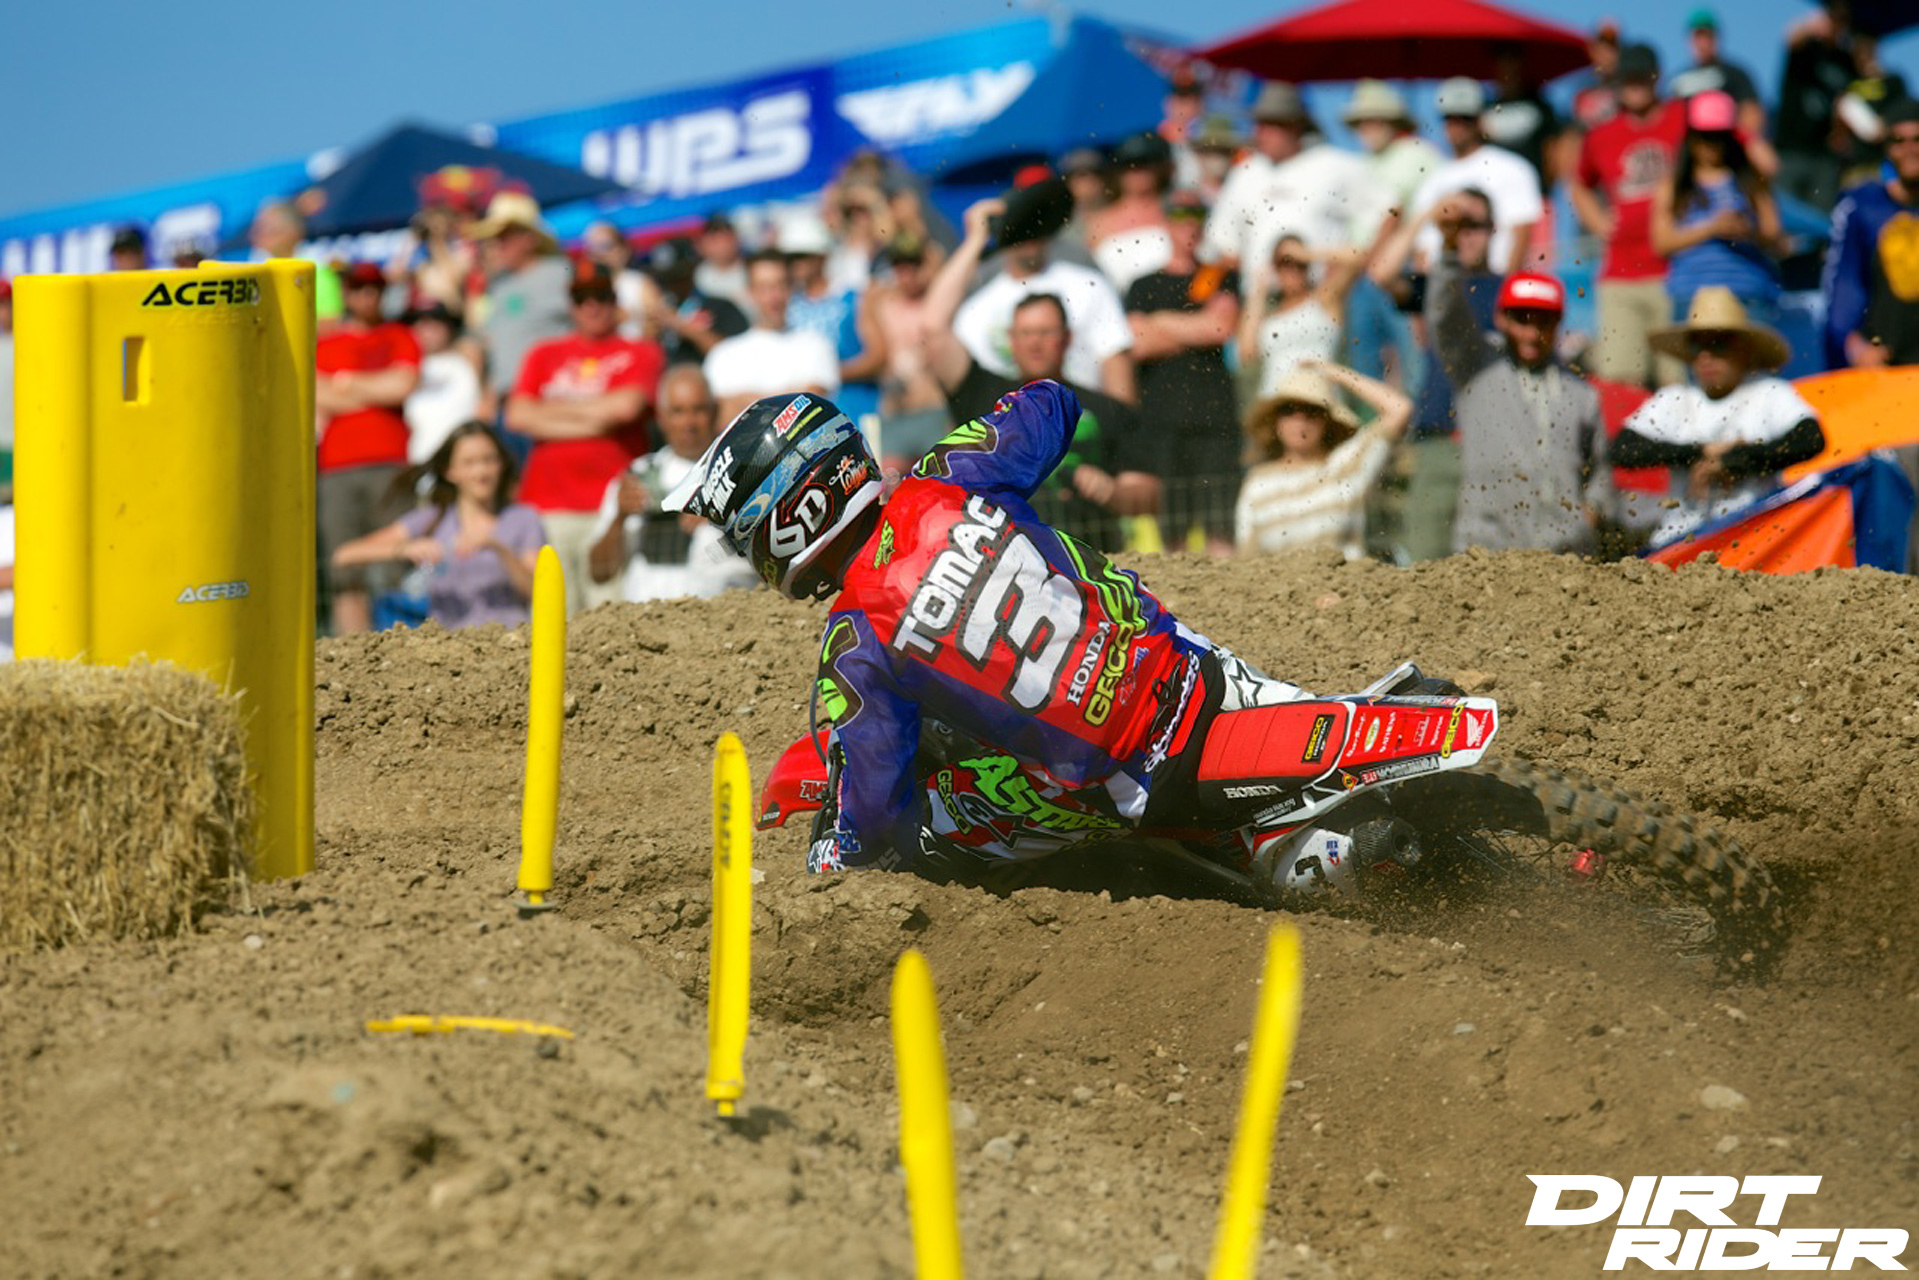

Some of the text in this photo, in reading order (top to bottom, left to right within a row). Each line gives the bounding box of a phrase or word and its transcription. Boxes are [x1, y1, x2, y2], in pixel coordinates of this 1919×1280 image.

[581, 89, 812, 198] WPS
[773, 395, 812, 437] AMSOIL
[701, 446, 734, 506] MUSCLE
[711, 471, 737, 519] MILK
[893, 494, 1007, 655] TOMAC
[962, 532, 1083, 709] 3
[1066, 620, 1112, 707] HONDA
[1084, 622, 1135, 726] GEICO
[1304, 717, 1325, 760] GEICO
[1441, 704, 1465, 758] GEICO
[937, 768, 973, 835] GEICO
[1222, 784, 1284, 799] HONDA
